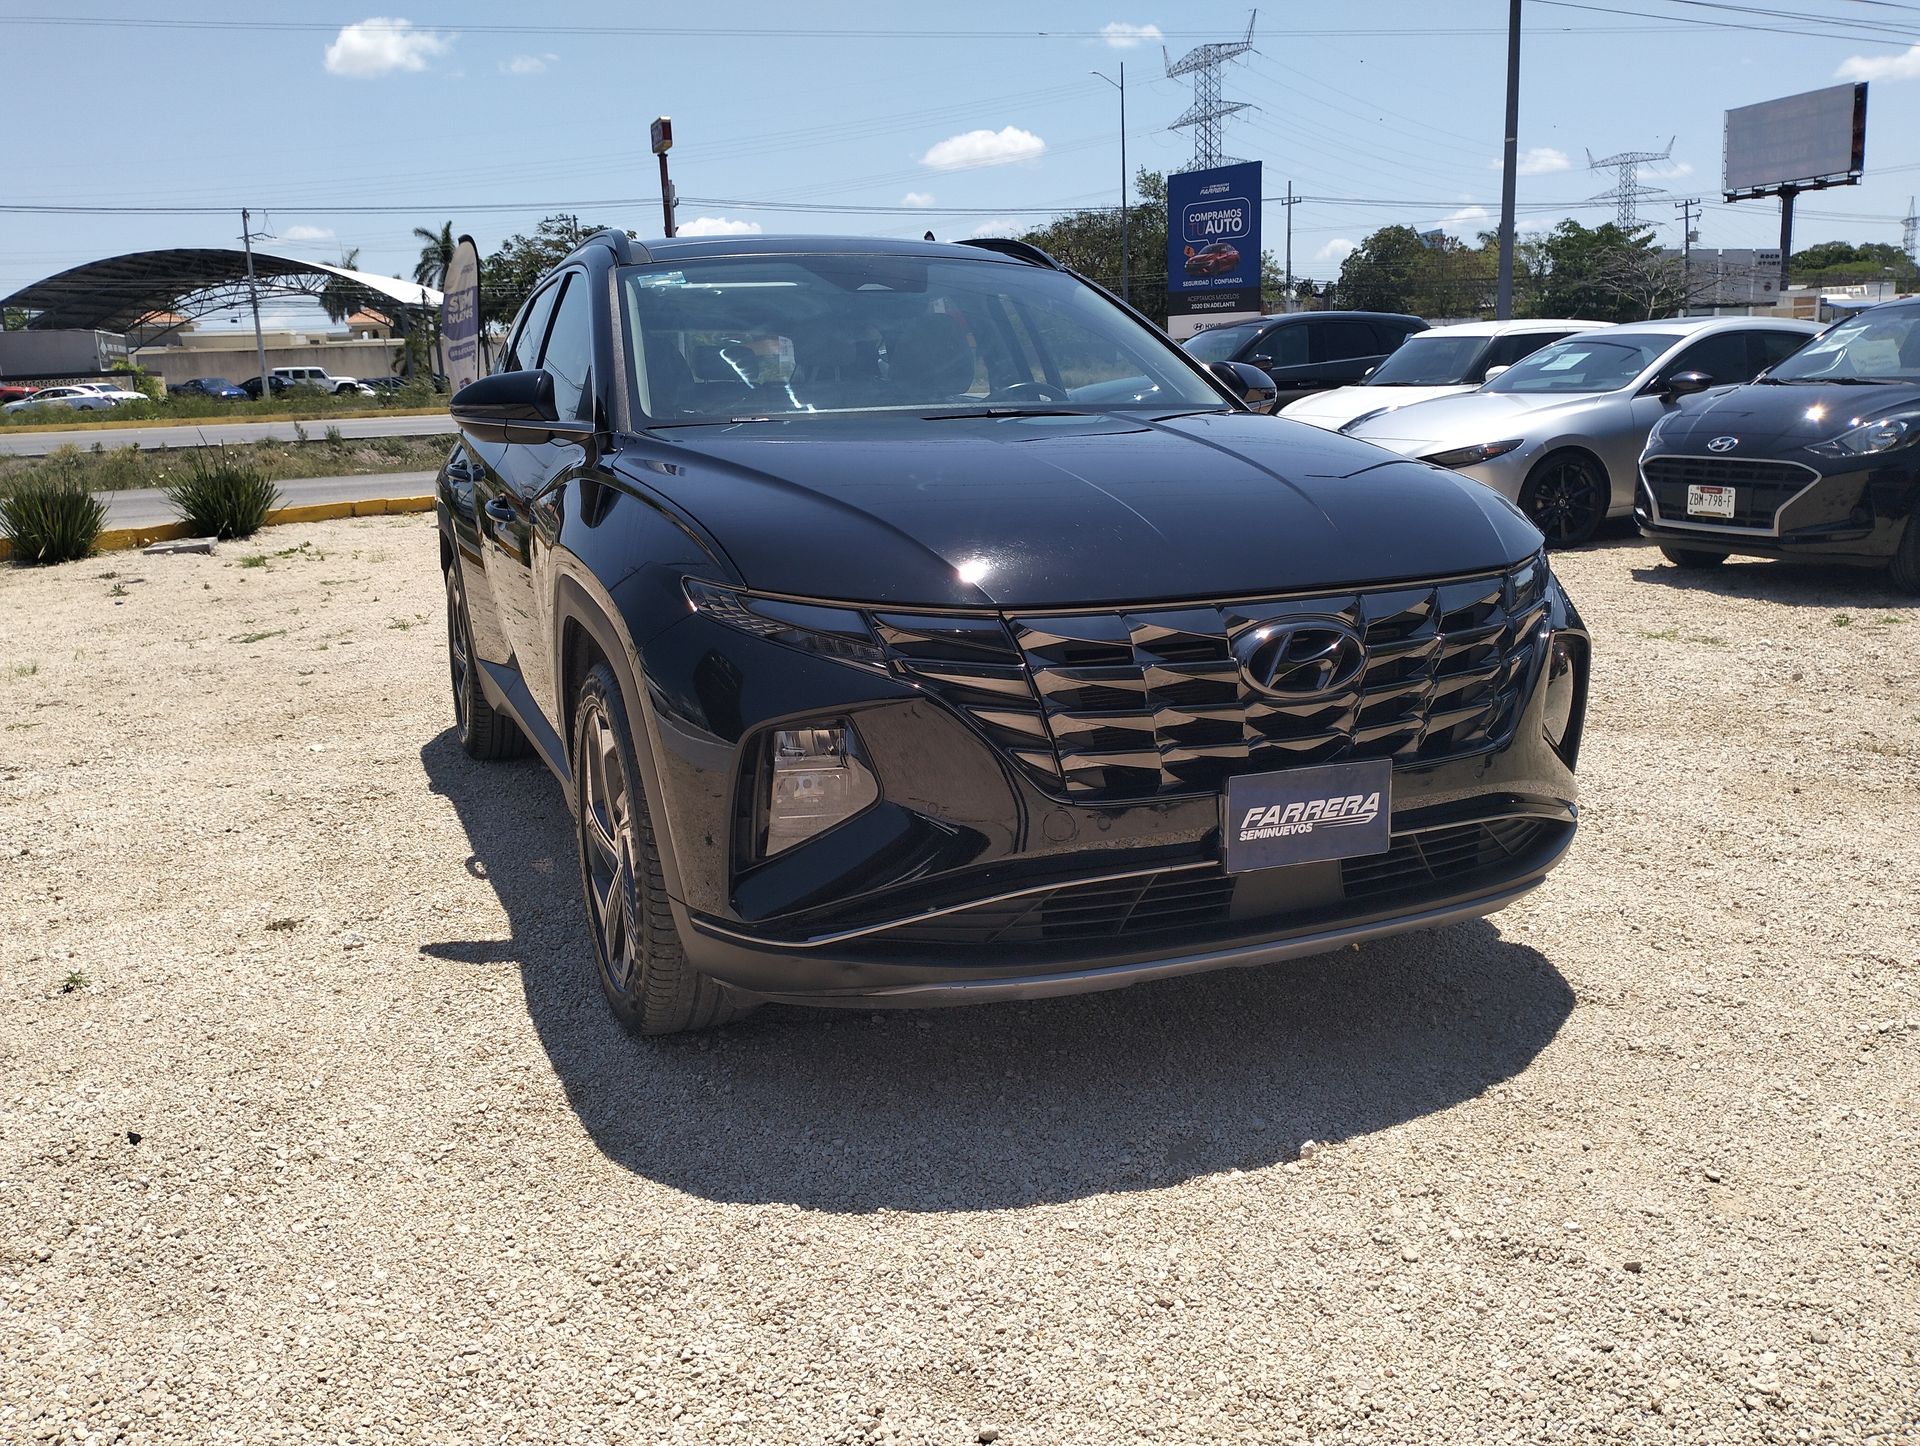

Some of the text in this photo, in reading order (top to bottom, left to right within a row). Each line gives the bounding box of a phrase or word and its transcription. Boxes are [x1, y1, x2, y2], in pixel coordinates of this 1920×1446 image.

[1189, 208, 1242, 222] COMPRAMOS
[1189, 217, 1243, 236] TU AUTO
[1182, 277, 1243, 287] SEGURIDAD CONFIANZA
[1187, 292, 1240, 302] ACEPTAMOS MODELOS
[1689, 493, 1732, 508] ZBM-798-F
[1240, 792, 1380, 829] FARRERA
[1239, 822, 1313, 842] SEMINUEVOS
